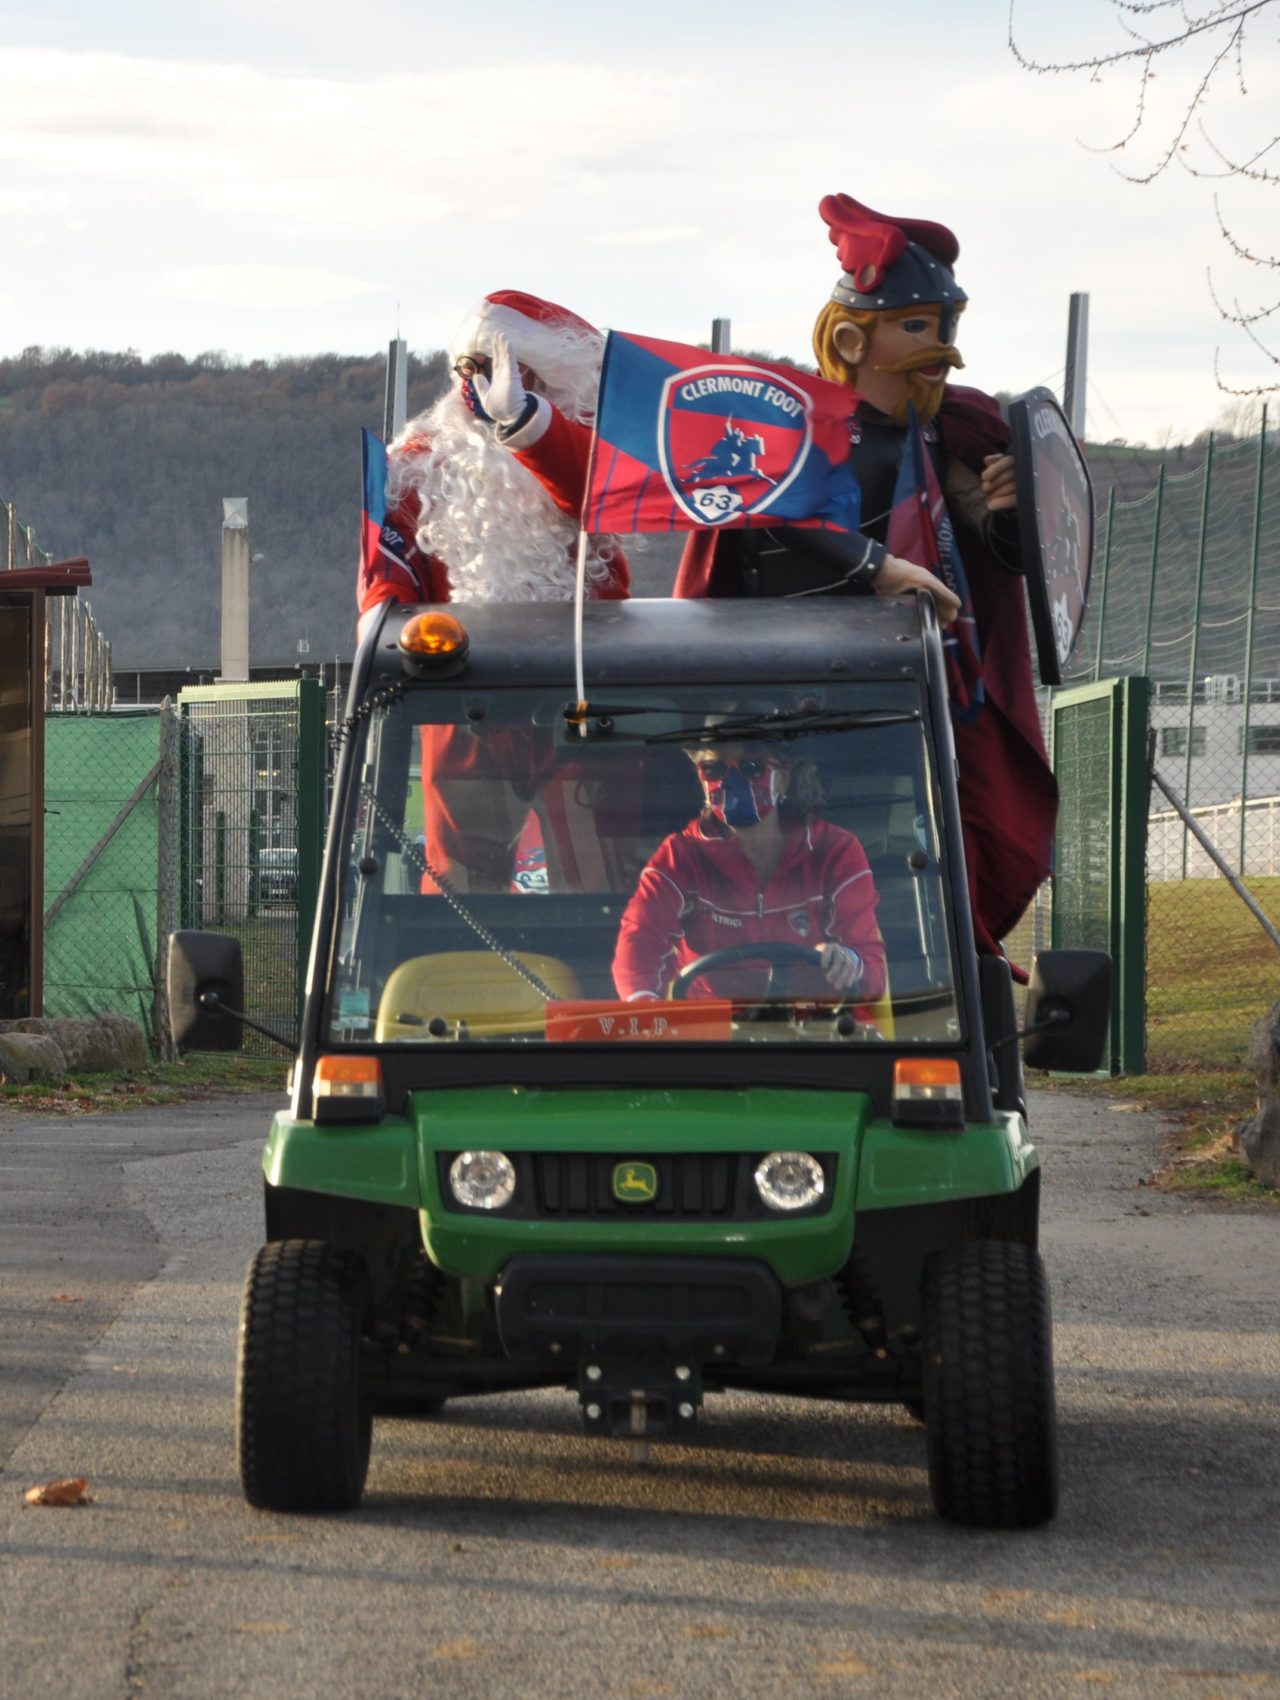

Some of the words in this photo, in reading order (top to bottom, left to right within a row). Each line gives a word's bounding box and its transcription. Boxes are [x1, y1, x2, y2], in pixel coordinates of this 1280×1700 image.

[680, 376, 765, 402] CLERMONT
[764, 385, 805, 418] FOOT
[699, 492, 733, 511] 63
[599, 1016, 678, 1036] V.I.P.
